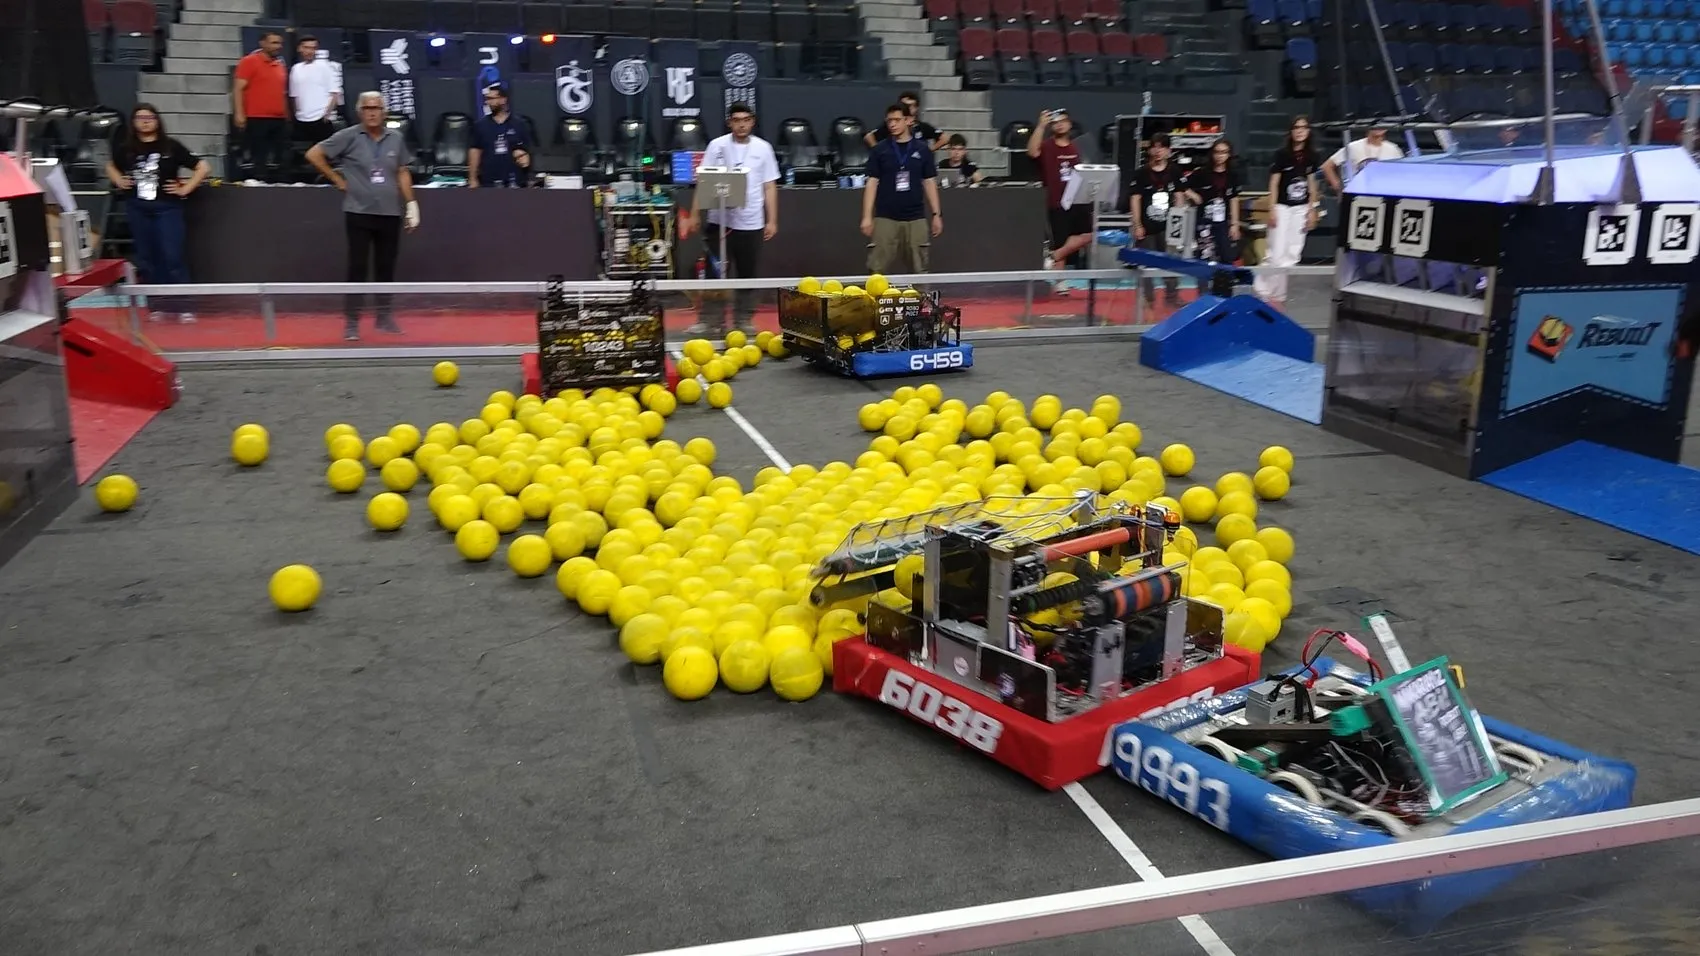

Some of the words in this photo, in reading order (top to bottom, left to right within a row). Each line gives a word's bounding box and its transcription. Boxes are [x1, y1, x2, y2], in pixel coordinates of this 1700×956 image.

[878, 297, 893, 305] arm
[910, 350, 963, 371] 6459
[879, 670, 1005, 754] 6038
[1114, 732, 1231, 833] 9993
